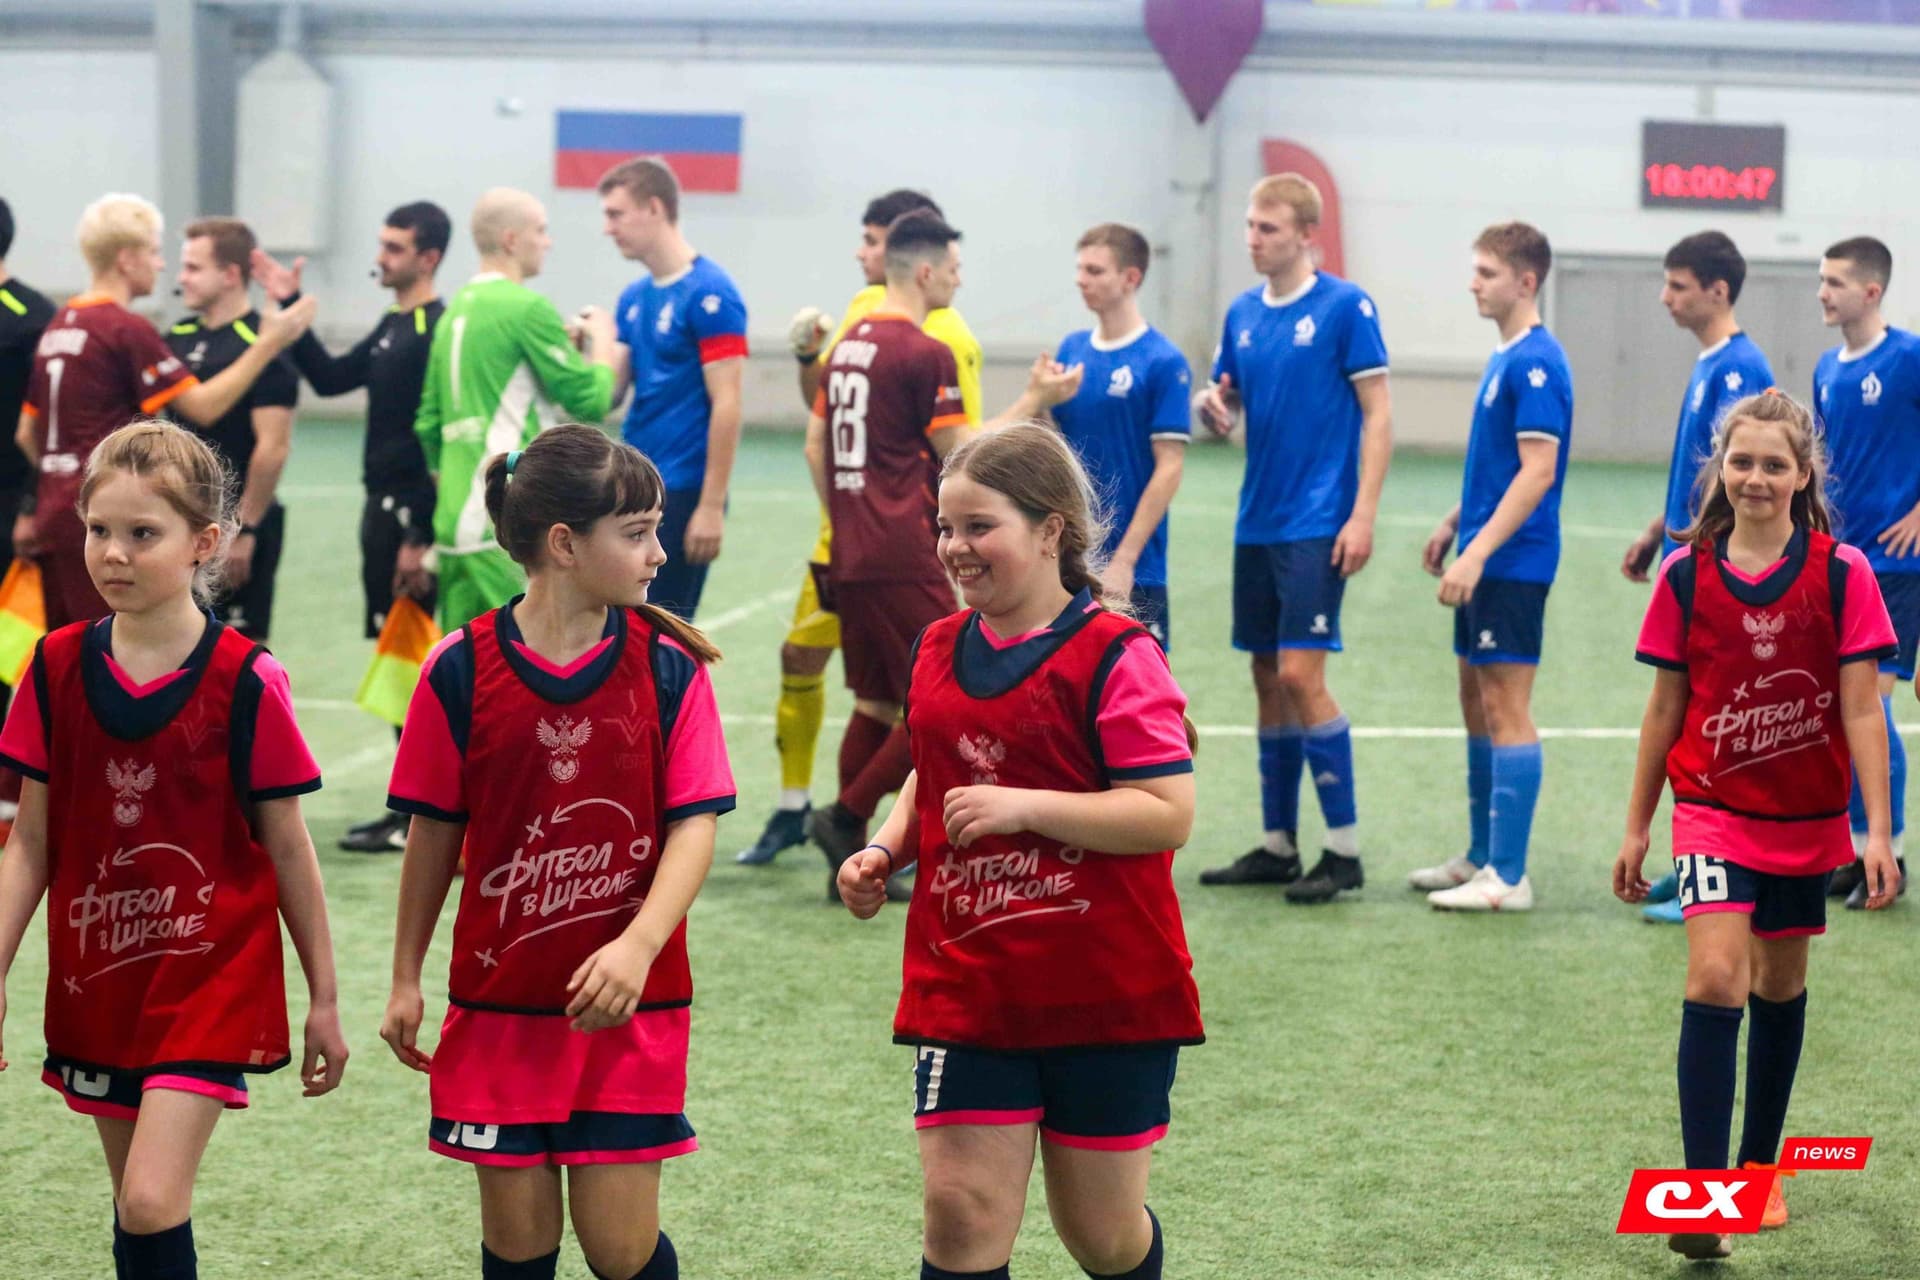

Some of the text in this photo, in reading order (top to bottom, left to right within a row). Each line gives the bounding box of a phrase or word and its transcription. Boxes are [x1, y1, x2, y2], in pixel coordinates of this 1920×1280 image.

[450, 317, 467, 412] 1
[46, 358, 65, 451] 1
[1701, 698, 1805, 760] ФУТБОЛ
[1750, 714, 1823, 753] ШКОЛЕ
[479, 841, 614, 928] ФУТБОЛ
[538, 867, 637, 917] ШКОЛЕ
[930, 847, 1040, 923] ФУТБОЛ
[973, 871, 1076, 917] ШКОЛЕ
[1675, 853, 1729, 909] 26
[109, 912, 207, 954] ШКОЛЕ
[913, 1045, 948, 1111] 7
